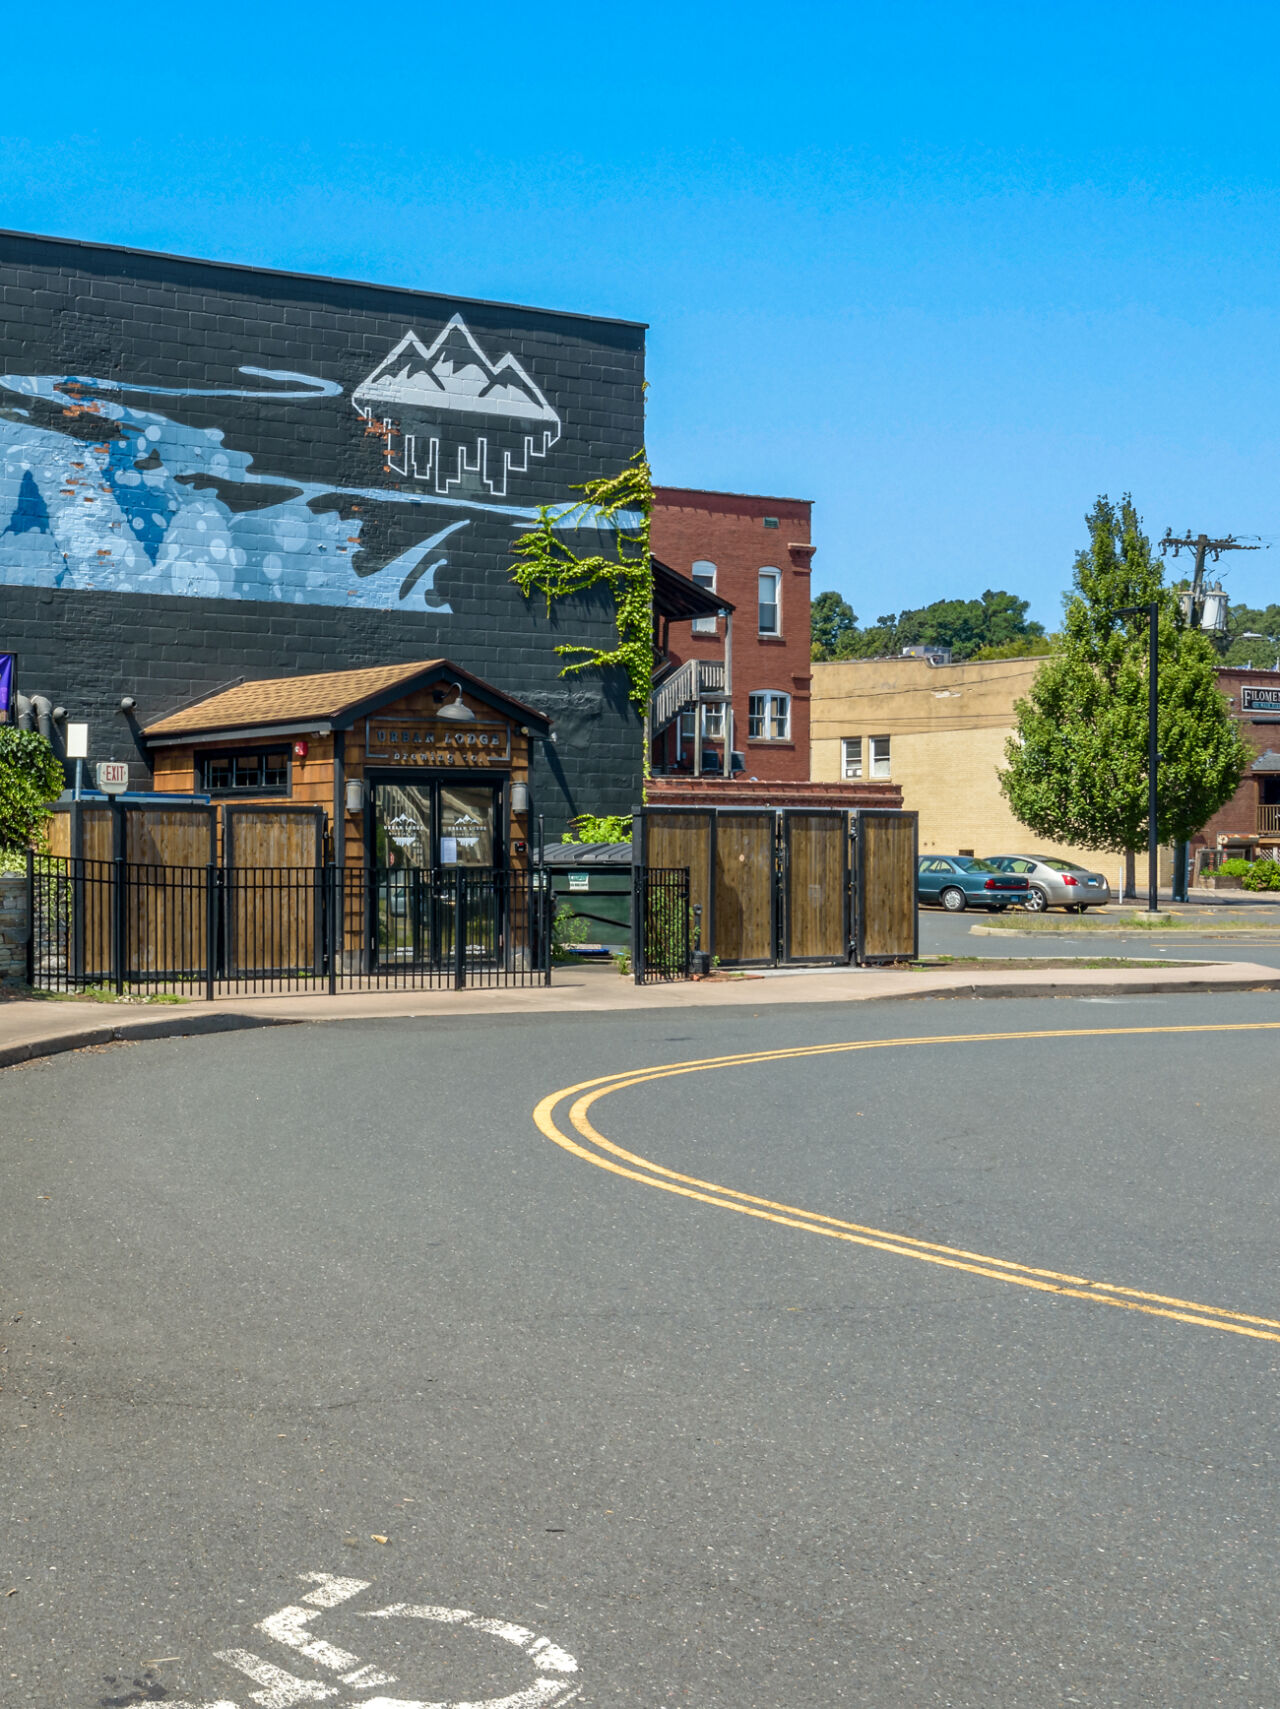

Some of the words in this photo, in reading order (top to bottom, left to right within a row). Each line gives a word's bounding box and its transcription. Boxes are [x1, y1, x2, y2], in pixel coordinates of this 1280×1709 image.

[377, 730, 435, 743] URBAN
[444, 732, 500, 745] LODGE
[106, 765, 125, 781] EXIT
